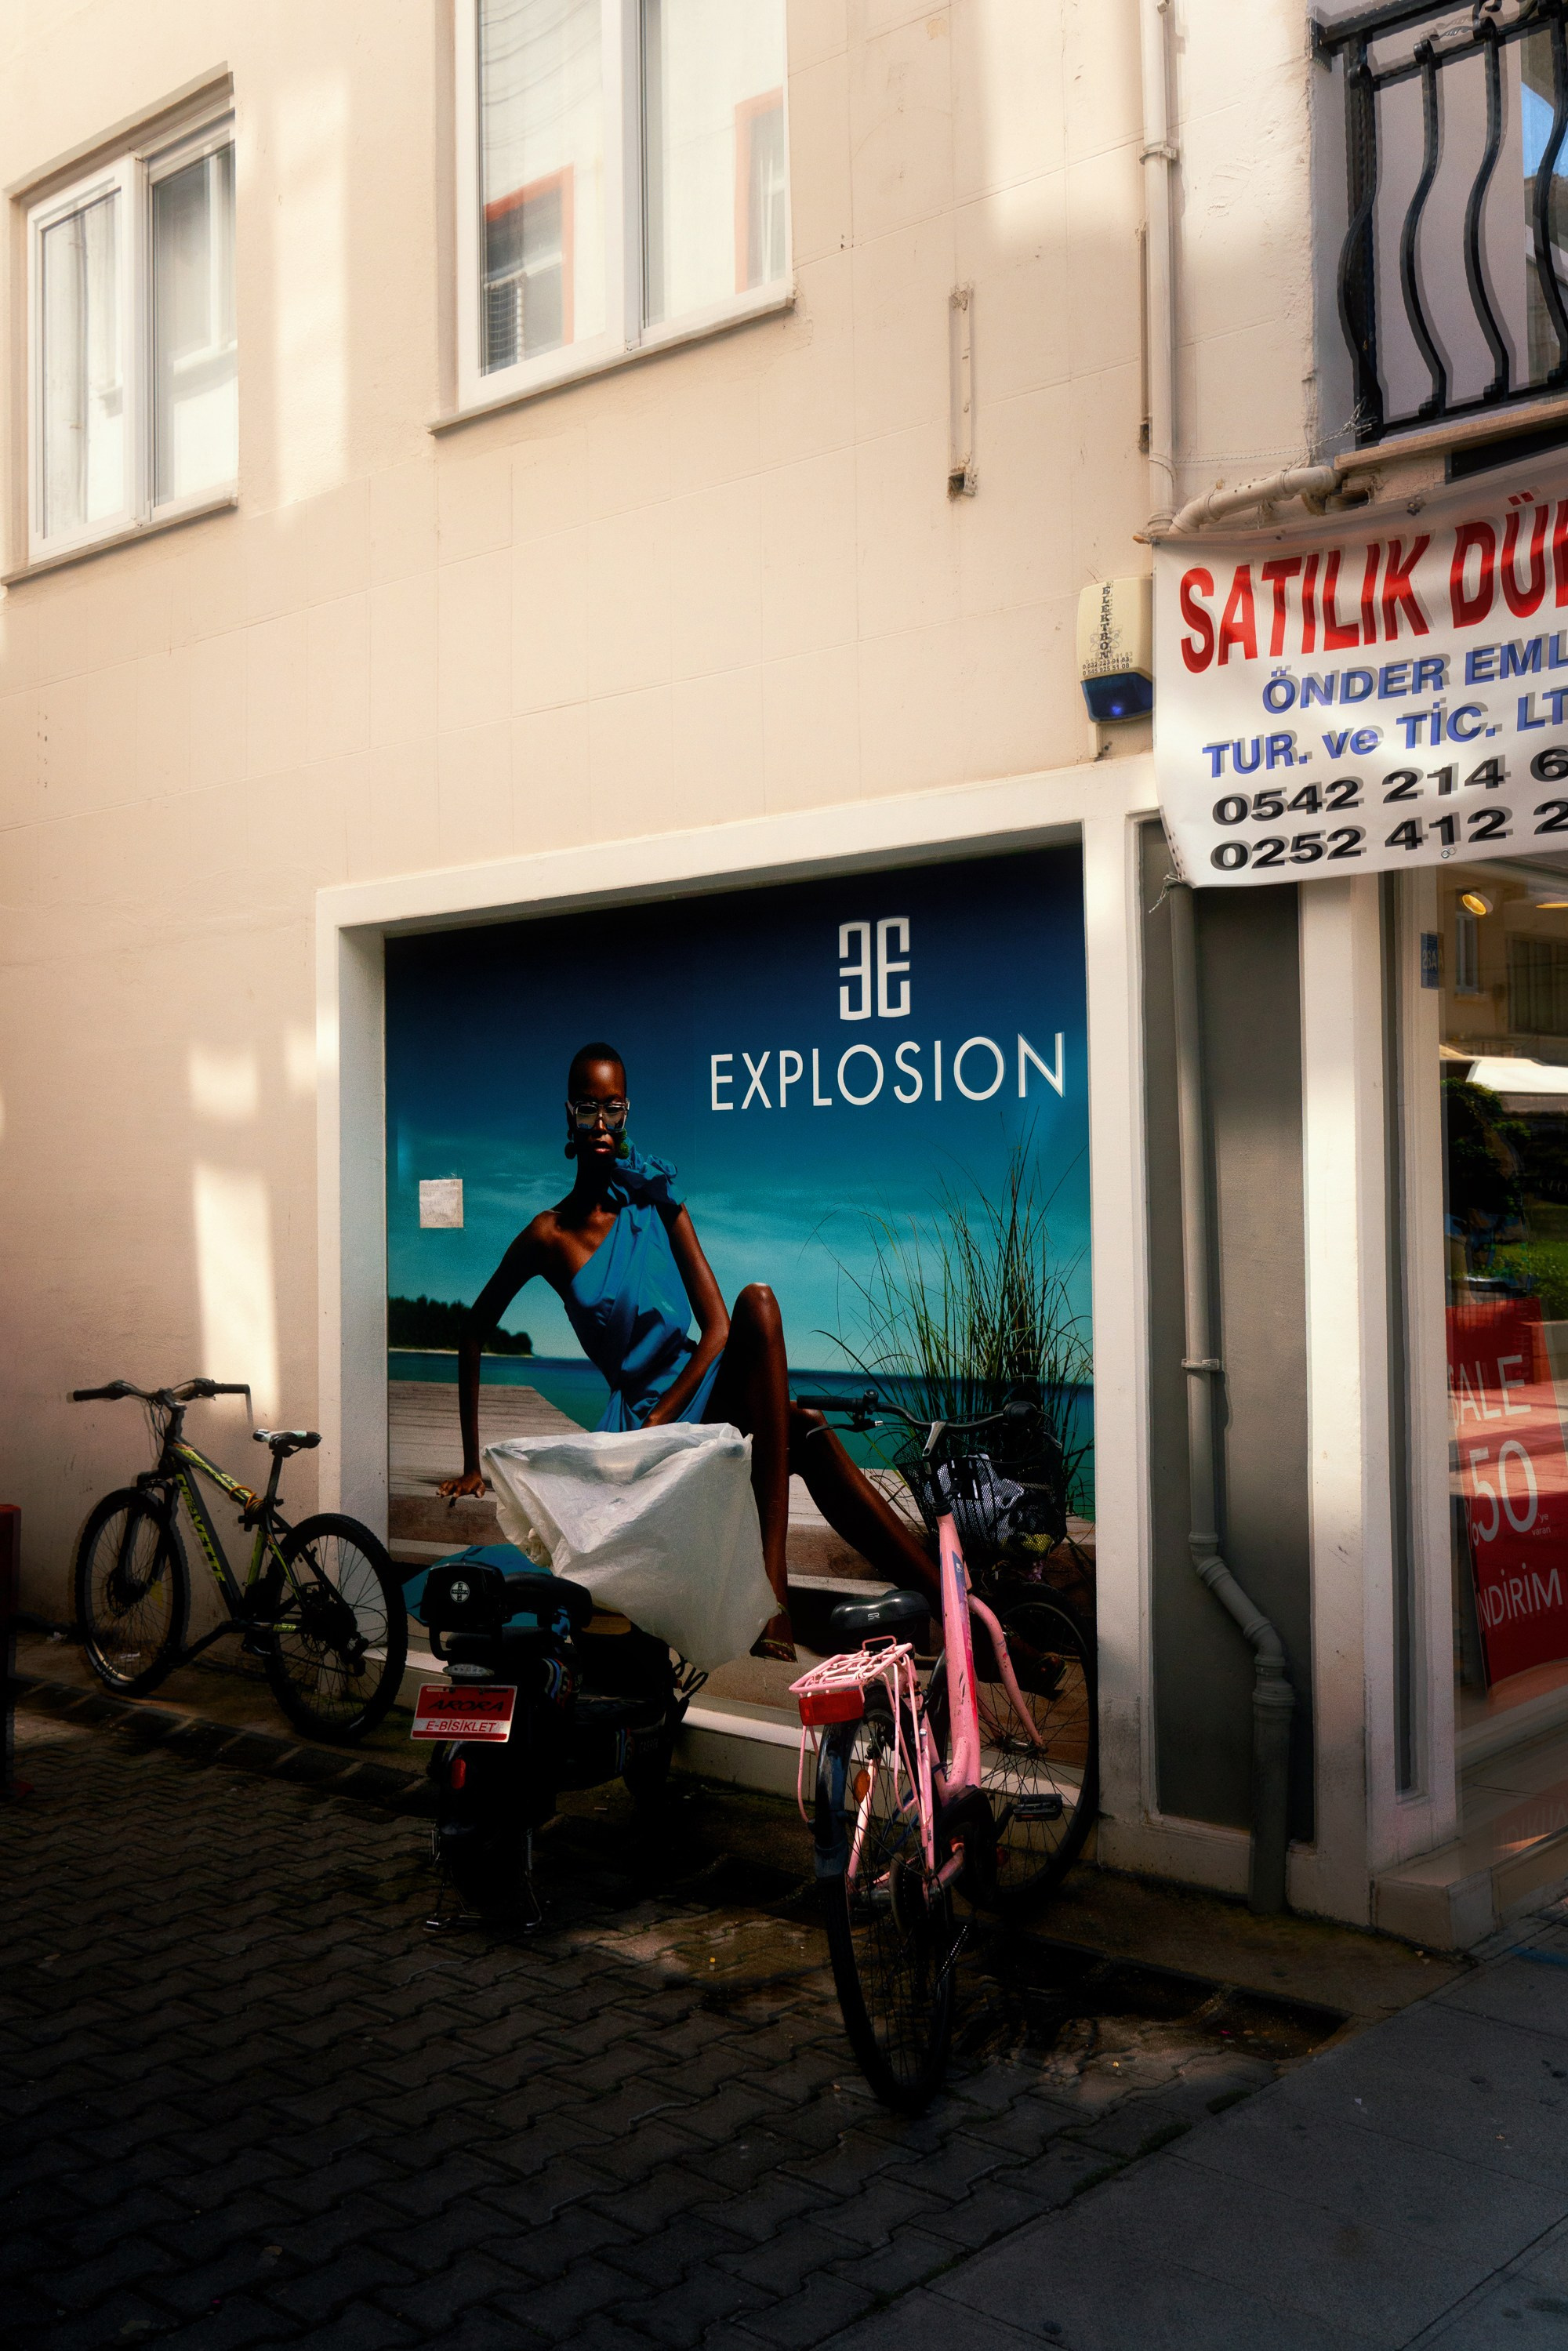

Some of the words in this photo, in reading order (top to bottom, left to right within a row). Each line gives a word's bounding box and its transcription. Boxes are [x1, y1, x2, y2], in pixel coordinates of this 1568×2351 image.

[1099, 586, 1111, 660] ELEKTRON
[1180, 535, 1430, 673] SATILIK
[1262, 657, 1446, 715] ÖNDER
[1202, 732, 1308, 778] TUR.
[1322, 729, 1379, 760] ve
[1396, 702, 1496, 749] TİC.
[1212, 778, 1362, 826] 0542
[1381, 758, 1505, 805] 214
[1530, 747, 1568, 782] 6
[1210, 829, 1363, 871] 0252
[1385, 808, 1508, 852] 412
[1533, 800, 1568, 836] 2
[710, 1032, 1065, 1111] EXPLOSION
[1531, 1526, 1552, 1536] varan
[426, 1719, 497, 1732] E-BİSİKLET
[427, 1699, 504, 1712] ARORA
